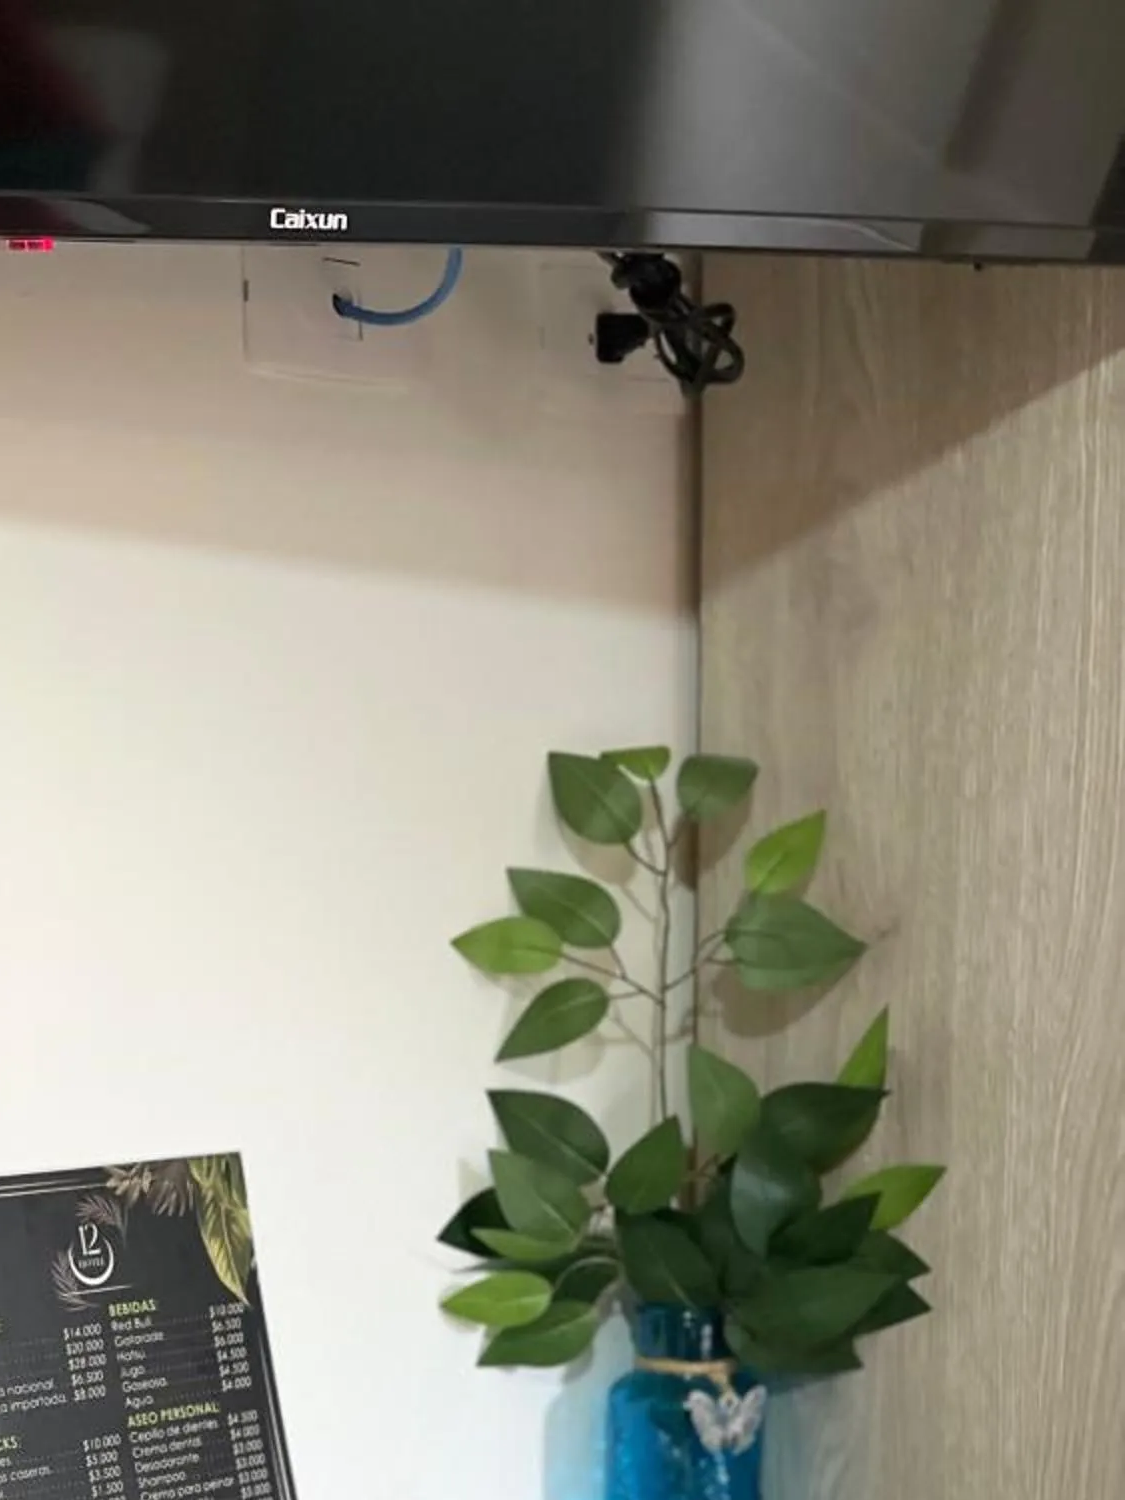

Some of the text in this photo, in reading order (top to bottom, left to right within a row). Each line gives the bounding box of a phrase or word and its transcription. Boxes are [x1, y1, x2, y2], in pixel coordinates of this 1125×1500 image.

[269, 207, 348, 231] Caixun
[127, 1411, 158, 1428] ASEO
[132, 1444, 168, 1459] Crema
[177, 1483, 202, 1498] para
